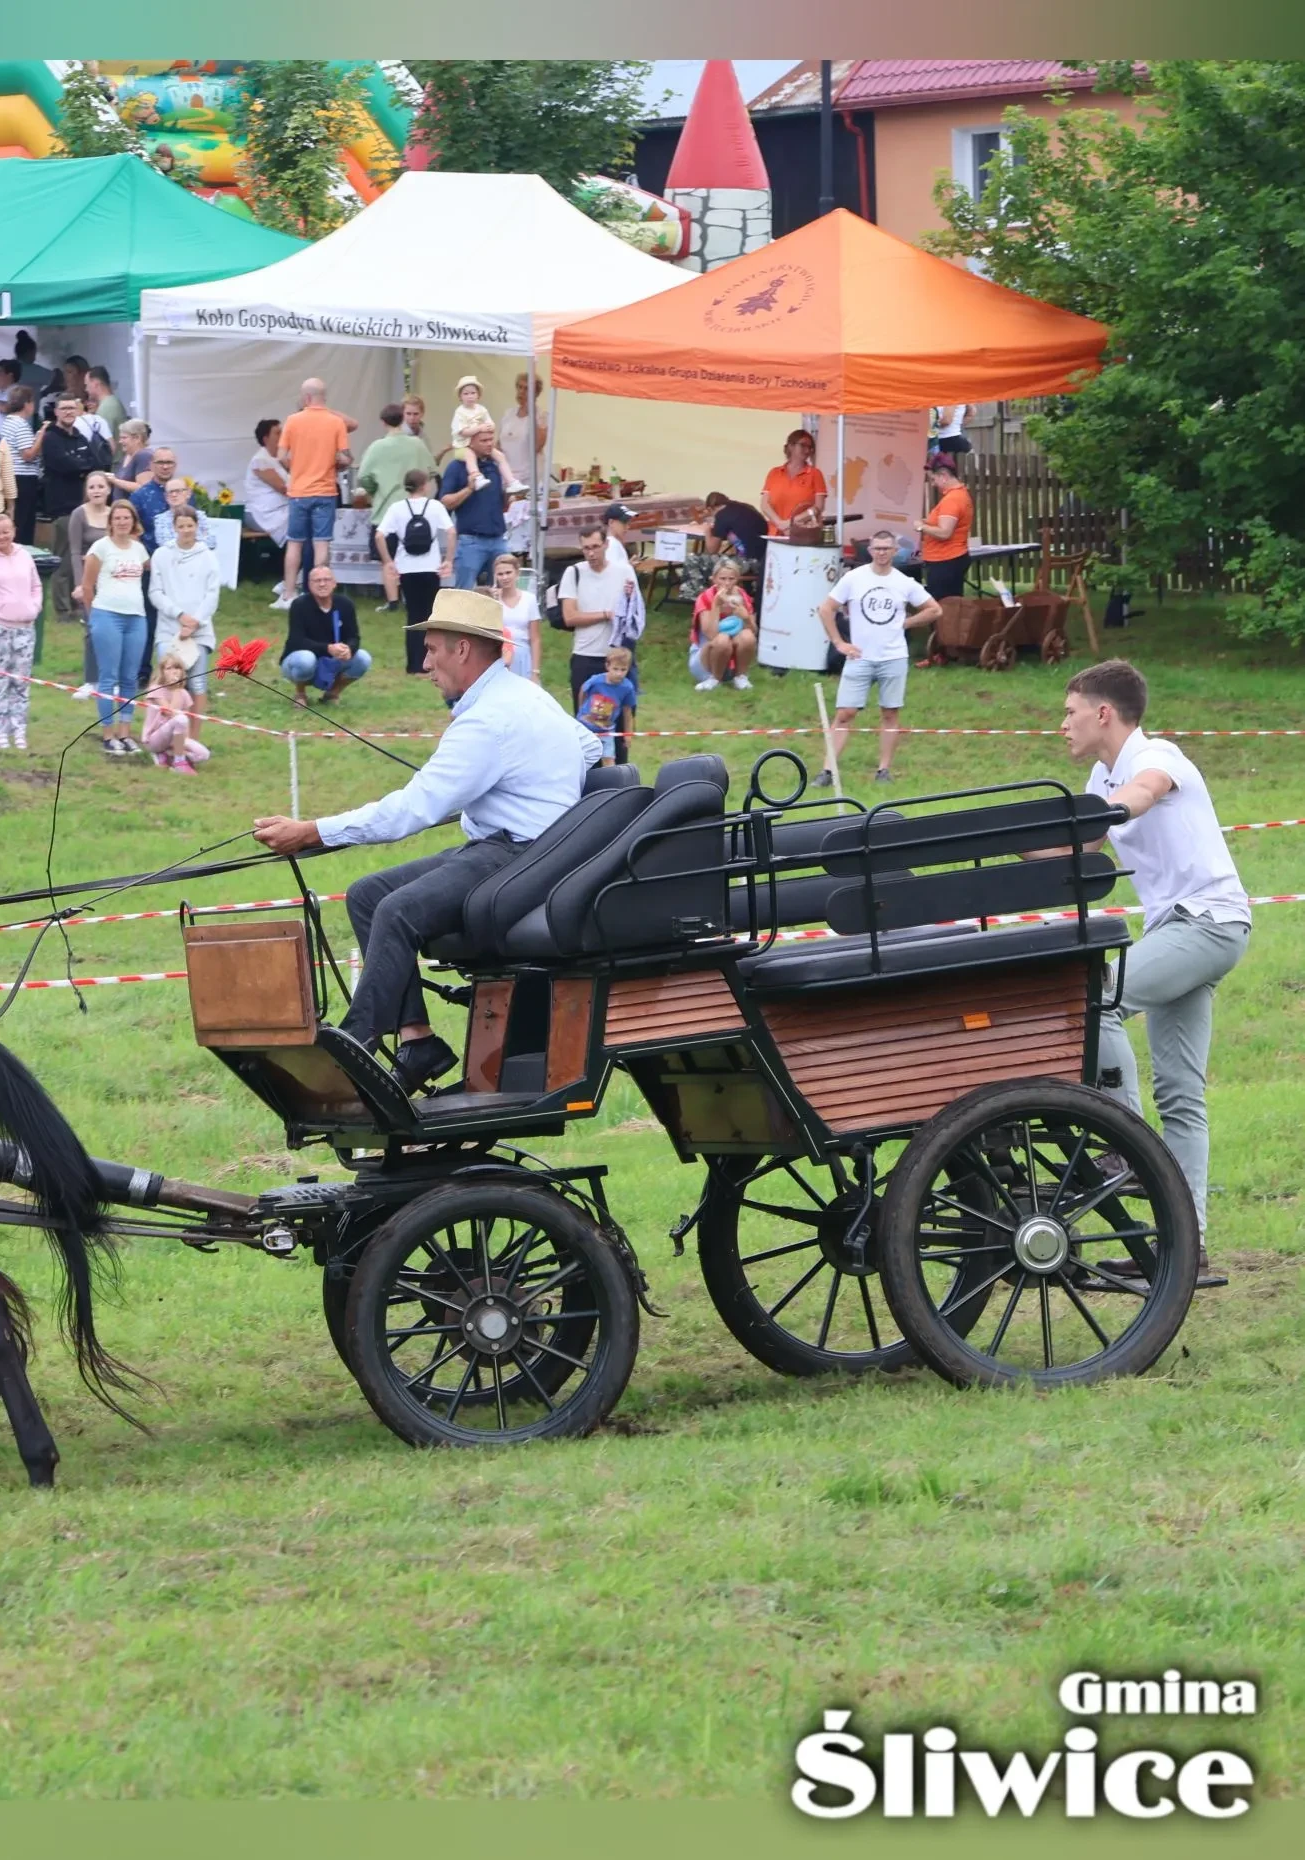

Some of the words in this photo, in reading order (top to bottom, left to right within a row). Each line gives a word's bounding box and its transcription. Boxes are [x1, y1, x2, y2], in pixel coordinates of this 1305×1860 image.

[196, 308, 234, 326] Koło
[238, 308, 317, 335] Gospodyń
[320, 315, 403, 337] Wiejskich
[408, 323, 424, 337] w
[668, 366, 698, 380] Grupa
[748, 373, 772, 389] Bory
